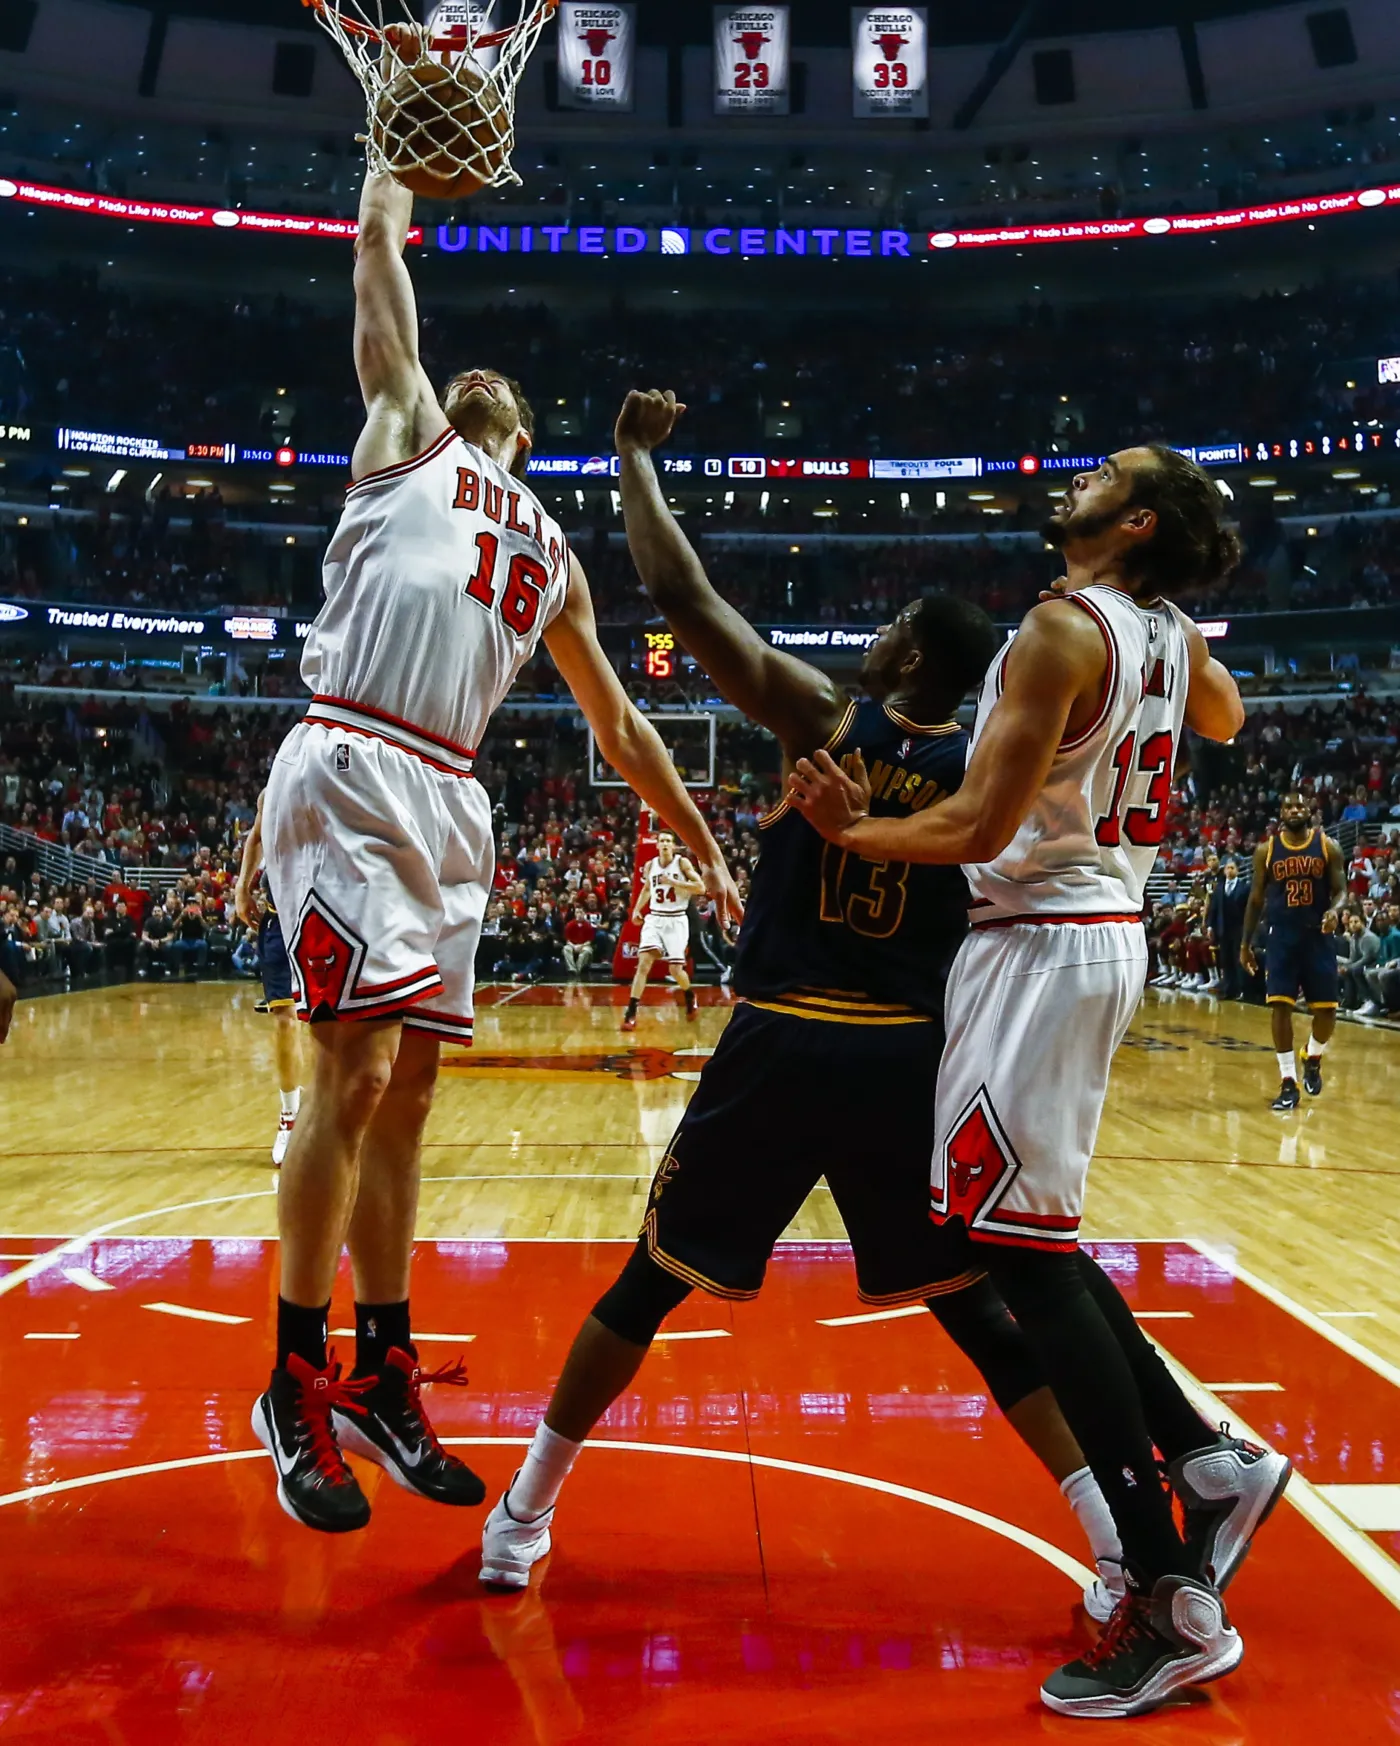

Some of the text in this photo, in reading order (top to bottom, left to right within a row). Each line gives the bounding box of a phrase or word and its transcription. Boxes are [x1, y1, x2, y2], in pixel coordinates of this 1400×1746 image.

[574, 9, 620, 18] CHICAGO
[728, 13, 774, 22] CHICAGO
[867, 14, 913, 23] CHICAGO
[581, 19, 614, 28] BULLS
[736, 22, 768, 30] BULLS
[874, 24, 907, 32] BULLS
[581, 59, 611, 85] 10
[734, 62, 769, 88] 23
[874, 63, 908, 88] 33
[98, 199, 127, 213] Made
[128, 204, 151, 216] Like
[152, 206, 168, 218] No
[1249, 207, 1278, 220] Made
[1279, 204, 1301, 217] Like
[1302, 202, 1318, 213] No
[318, 221, 346, 233] Made
[1033, 228, 1061, 238] Made
[1062, 227, 1083, 236] Like
[1085, 225, 1100, 235] No
[437, 225, 911, 256] UNITED CENTER
[8, 426, 31, 441] PM
[71, 430, 159, 448] HOUSTON ROCKETS
[1304, 441, 1315, 453] 3
[1338, 437, 1348, 449] 4
[1371, 435, 1381, 447] T
[71, 441, 169, 460] LOS ANGELES CLIPPERS
[188, 445, 224, 458] 9:30 PM
[242, 450, 349, 465] BMO HARRIS
[1199, 448, 1237, 462] POINTS
[1243, 447, 1250, 459] 1
[1272, 445, 1282, 456] 2
[663, 460, 692, 472] 7:55
[712, 463, 718, 471] 1
[739, 461, 756, 473] 10
[802, 461, 850, 475] BULLS
[987, 461, 1016, 471] BMO
[1043, 457, 1094, 469] HARRIS
[463, 530, 550, 640] 16
[48, 608, 204, 634] Trusted Everywhere
[644, 633, 674, 650] 7:55
[771, 630, 879, 648] Trusted Every
[648, 649, 669, 677] 15
[1094, 730, 1173, 848] 13
[1272, 857, 1324, 881] CAVS
[819, 838, 910, 938] 13
[1286, 879, 1313, 907] 23
[655, 888, 677, 904] 34
